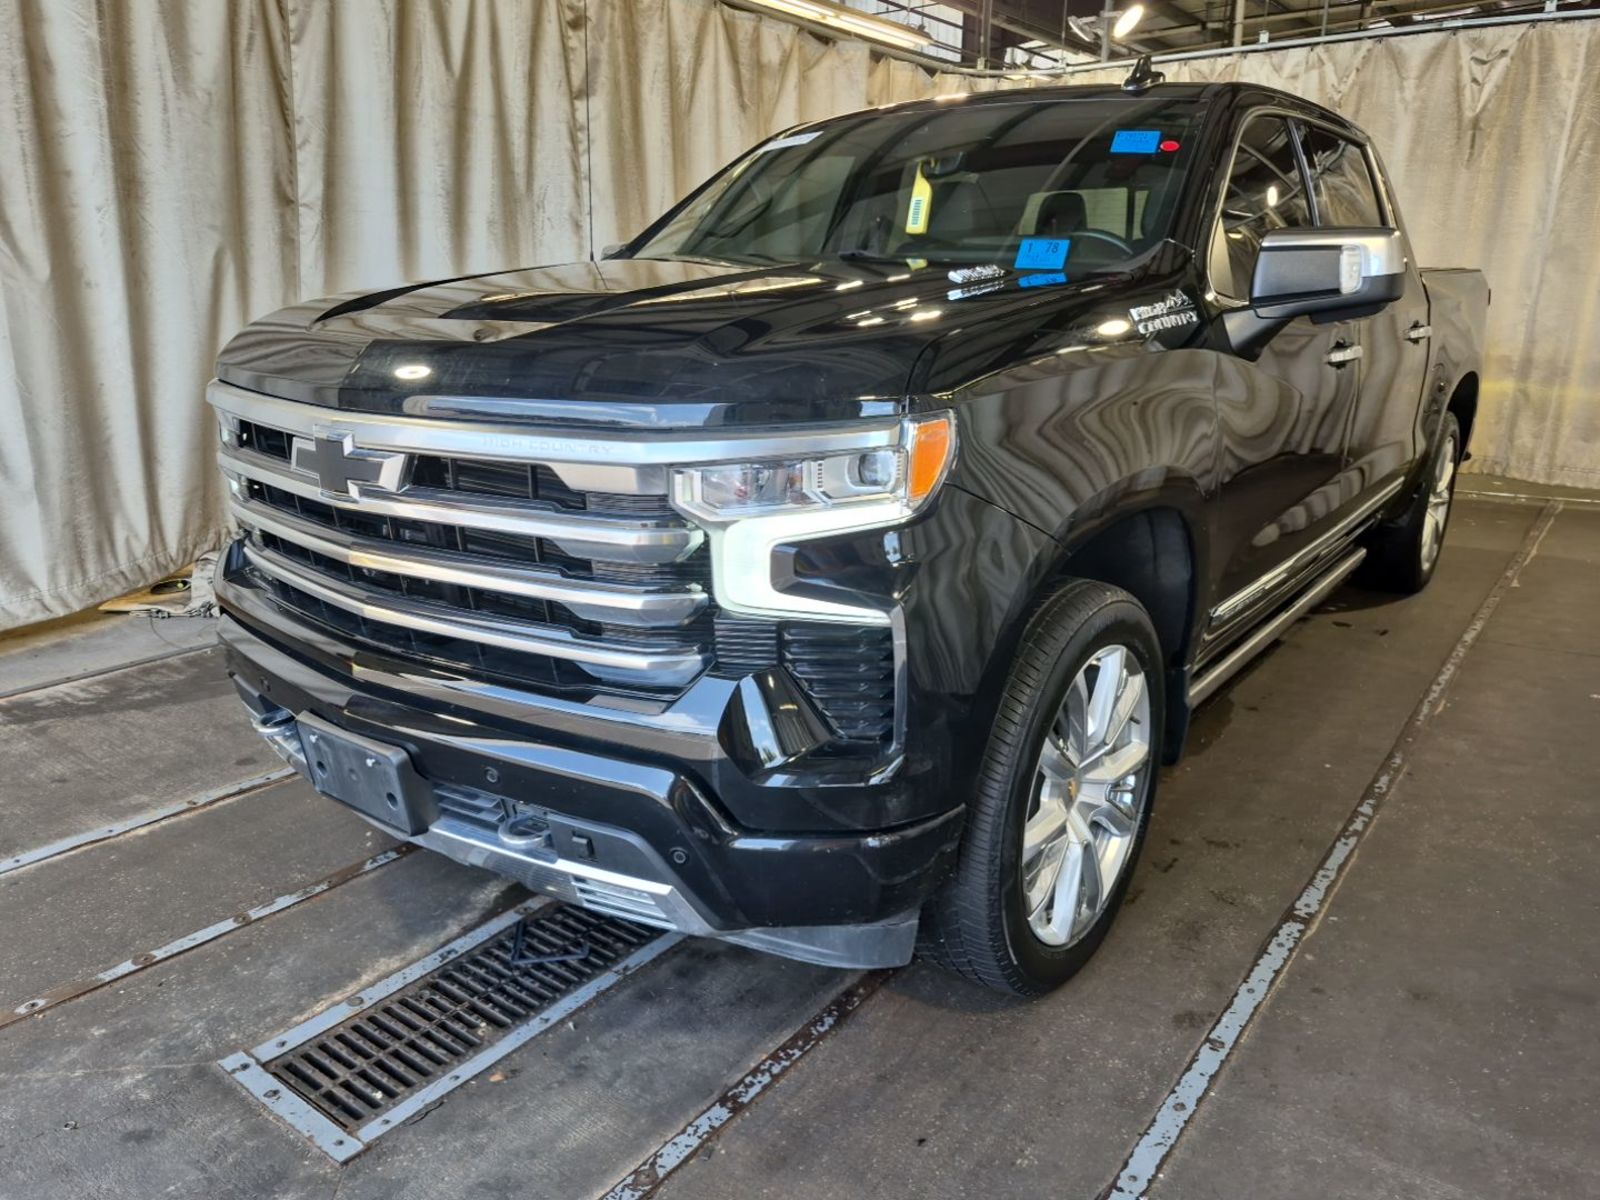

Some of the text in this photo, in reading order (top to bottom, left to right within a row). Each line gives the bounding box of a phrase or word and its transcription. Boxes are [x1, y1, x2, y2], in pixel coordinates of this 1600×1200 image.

[1046, 241, 1061, 254] 78
[482, 436, 612, 455] HIGH COUNTRY
